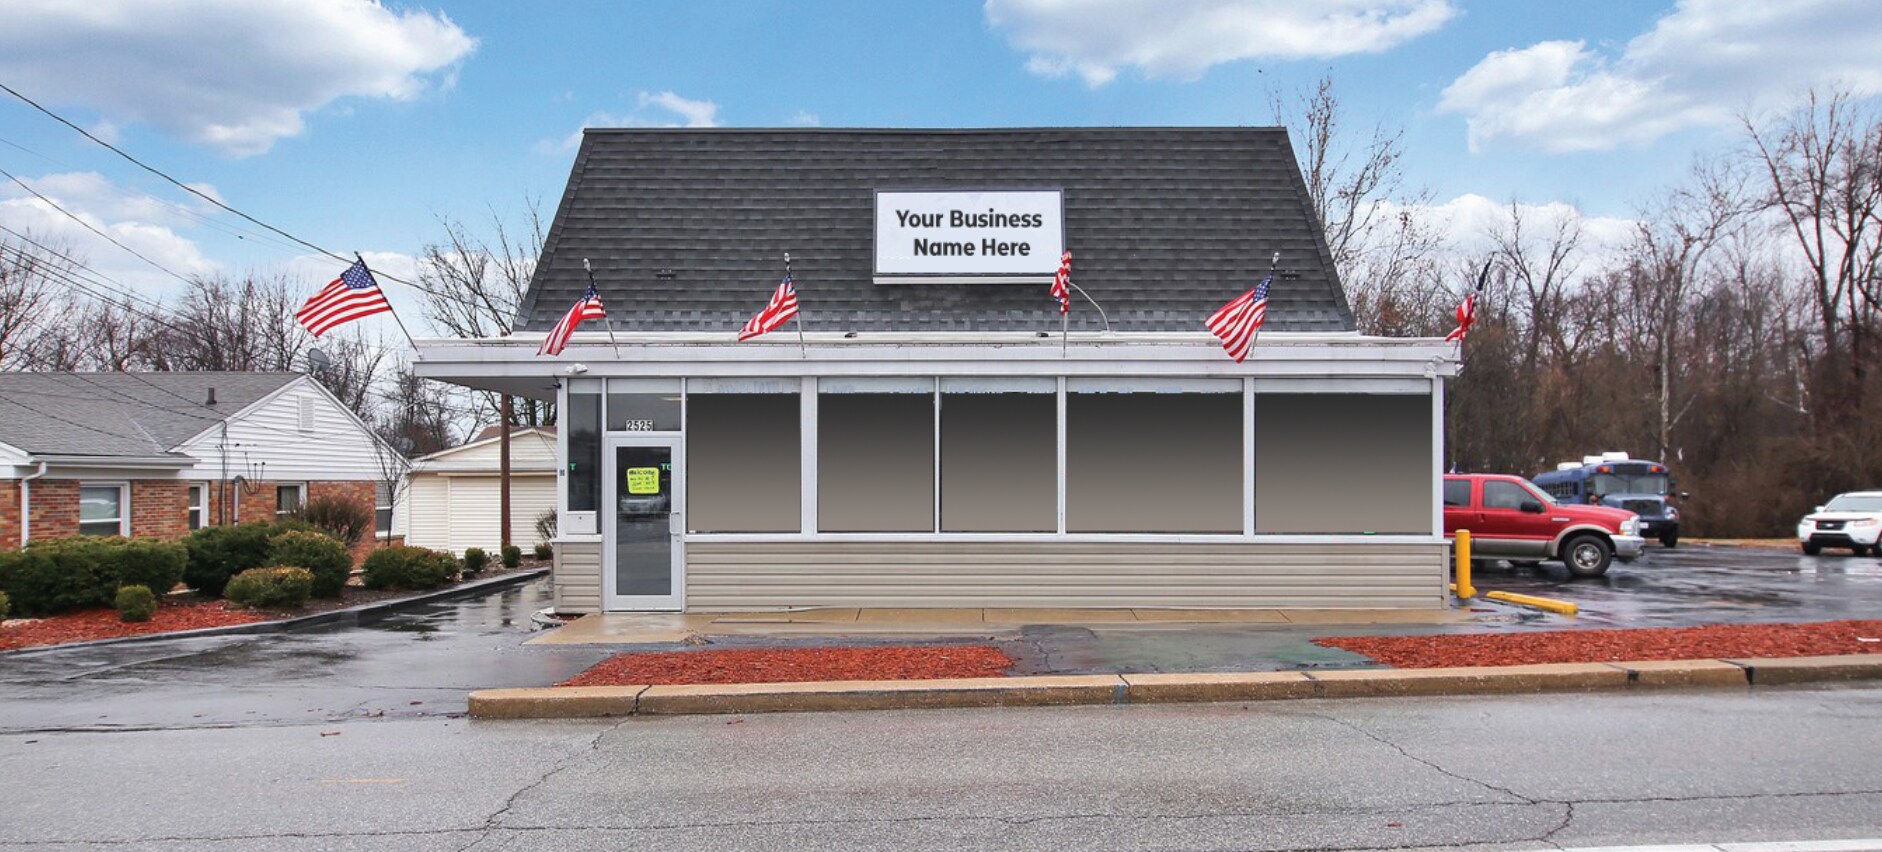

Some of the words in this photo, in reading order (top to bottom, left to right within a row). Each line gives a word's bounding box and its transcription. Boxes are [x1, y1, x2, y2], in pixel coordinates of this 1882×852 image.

[896, 209, 943, 228] Your
[950, 208, 1043, 228] Business
[913, 238, 976, 256] Name
[981, 238, 1031, 256] Here
[626, 420, 652, 431] 2525
